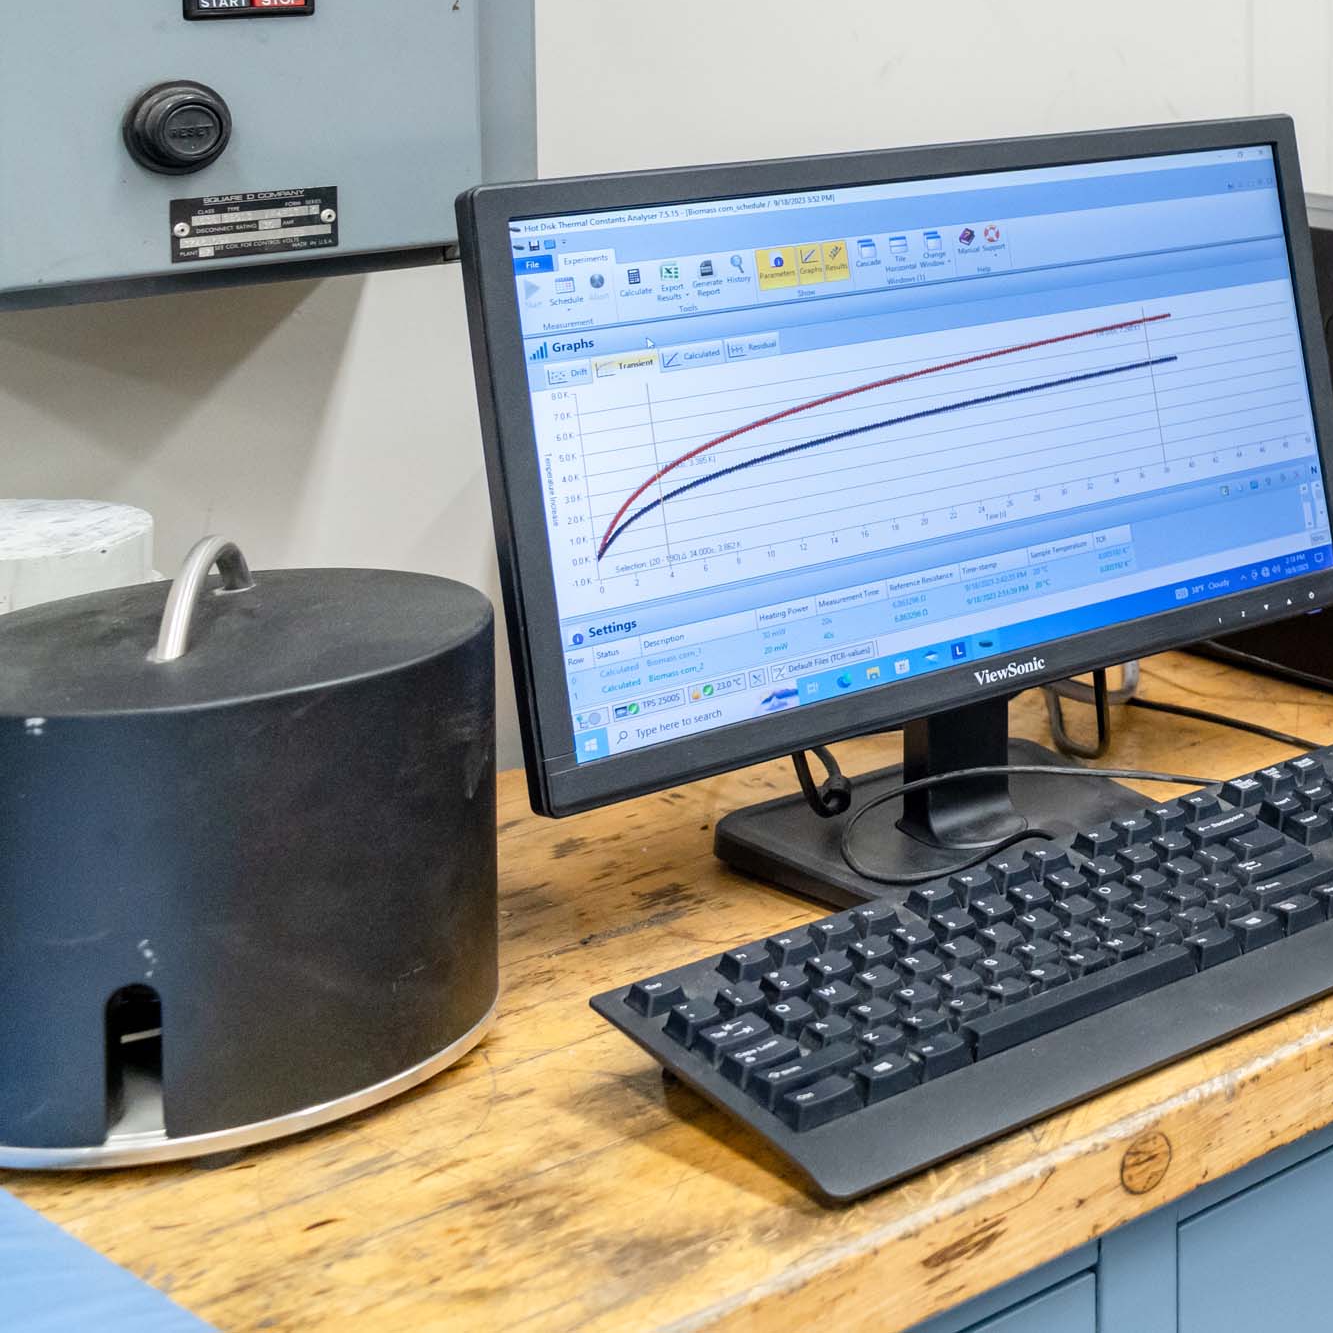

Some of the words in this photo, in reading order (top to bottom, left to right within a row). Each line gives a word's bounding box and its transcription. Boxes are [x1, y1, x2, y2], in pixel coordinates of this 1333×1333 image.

[169, 126, 211, 139] RESET
[203, 195, 242, 204] SQUARE
[258, 189, 304, 200] COMPANY
[524, 225, 539, 233] Hot
[541, 222, 556, 232] Disk
[558, 220, 588, 229] Thermal
[590, 215, 626, 226] Constants
[627, 213, 657, 224] Analyser
[196, 226, 234, 234] DISCONNECT
[957, 246, 981, 255] Manual
[982, 243, 1006, 254] Support
[525, 260, 540, 269] File
[563, 253, 609, 267] Experiments
[922, 250, 947, 260] Change
[825, 263, 849, 273] Results
[855, 259, 881, 267] Cascade
[919, 258, 945, 268] Window
[759, 268, 796, 280] Parameters
[799, 265, 823, 277] Graphs
[976, 265, 992, 274] Help
[692, 277, 723, 289] Generate
[727, 274, 752, 286] History
[886, 275, 914, 285] Windows
[619, 286, 653, 298] Calculate
[661, 282, 684, 294] Export
[697, 287, 721, 299] Report
[796, 289, 816, 297] Show
[550, 294, 584, 307] Schedule
[657, 292, 683, 302] Results
[679, 303, 698, 313] Tools
[543, 318, 594, 331] Measurement
[552, 337, 595, 354] Graphs
[571, 368, 588, 378] Drift
[618, 358, 654, 371] Transient
[683, 348, 721, 361] Calculated
[748, 340, 777, 353] Residual
[768, 550, 775, 558] 10
[800, 543, 807, 551] 12
[831, 536, 839, 544] 14
[861, 530, 869, 538] 16
[1208, 579, 1230, 591] Cloudy
[567, 656, 585, 666] Row
[596, 648, 620, 660] Status
[643, 633, 685, 649] Description
[759, 609, 786, 623] Heating
[787, 604, 809, 617] Power
[818, 591, 861, 608] Measurement
[862, 587, 880, 598] Time
[888, 579, 920, 592] Reference
[921, 571, 954, 585] Resistance
[588, 619, 637, 638] Settings
[642, 697, 657, 709] TPS
[658, 692, 681, 706] 2500S
[716, 680, 732, 691] 23.0
[788, 660, 813, 673] Default
[814, 656, 829, 667] Files
[830, 646, 871, 664] (TCR-values)
[974, 656, 1046, 687] ViewSonic
[601, 678, 641, 694] Calculated
[648, 669, 680, 683] Biomass
[635, 725, 658, 739] Type
[660, 720, 681, 734] here
[682, 717, 693, 727] to
[693, 708, 723, 726] search
[1211, 813, 1245, 828] Backspace
[984, 928, 996, 936] Y
[862, 972, 877, 980] E
[819, 986, 836, 996] W
